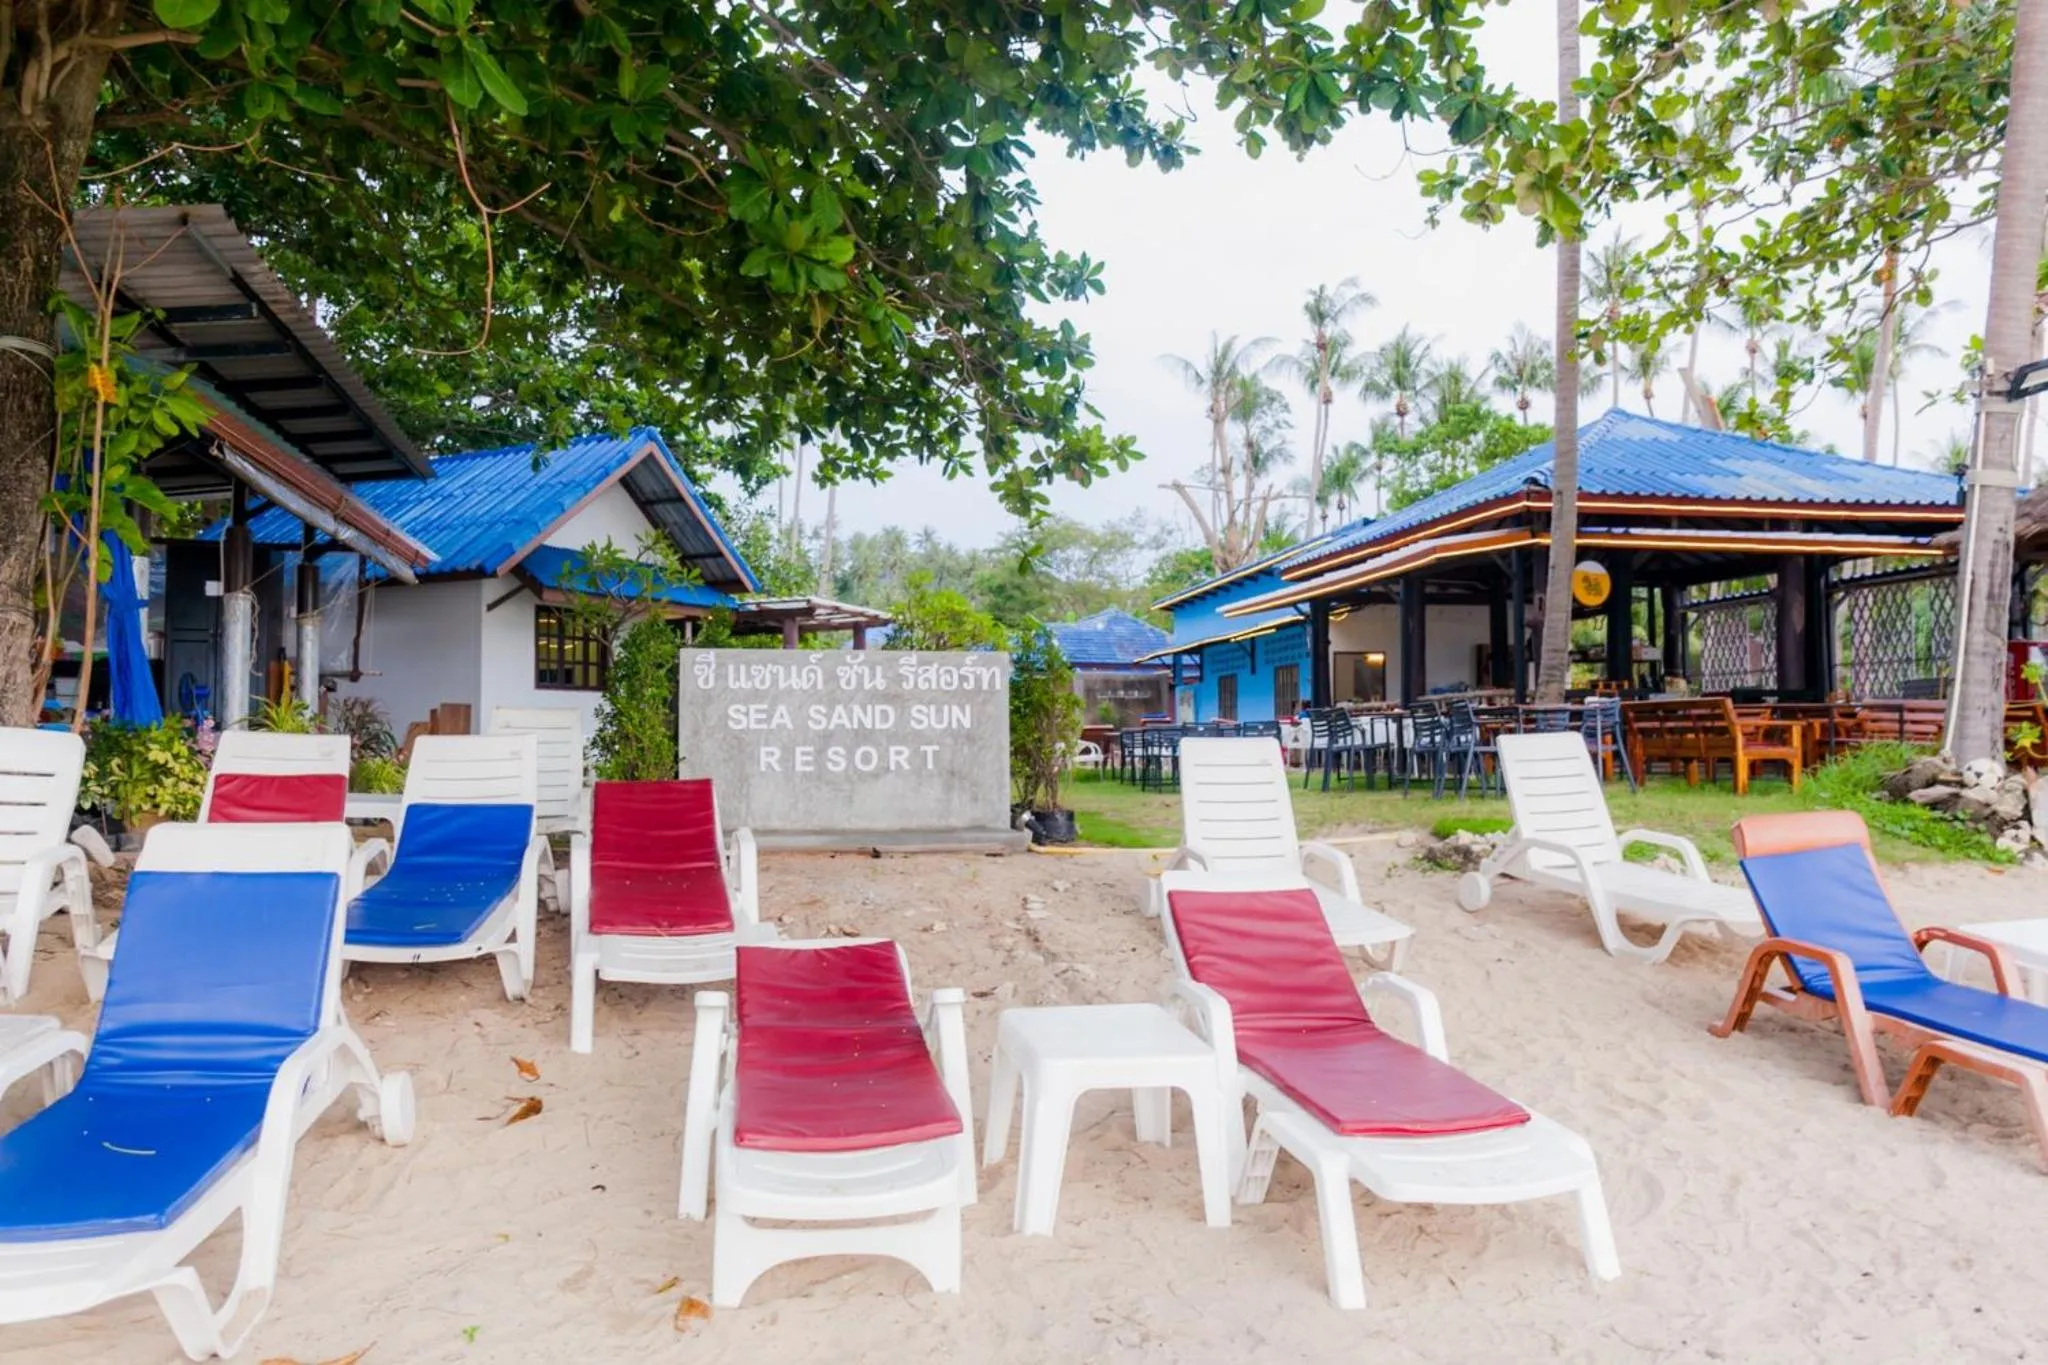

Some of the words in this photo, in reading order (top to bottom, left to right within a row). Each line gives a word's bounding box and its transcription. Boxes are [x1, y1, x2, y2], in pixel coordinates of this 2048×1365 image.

[727, 652, 824, 690] แซนด์
[898, 650, 1001, 690] รีสอร์ท
[727, 704, 793, 730] SEA
[807, 704, 895, 730] SAND
[910, 703, 972, 730] SUN
[759, 744, 940, 772] RESORT
